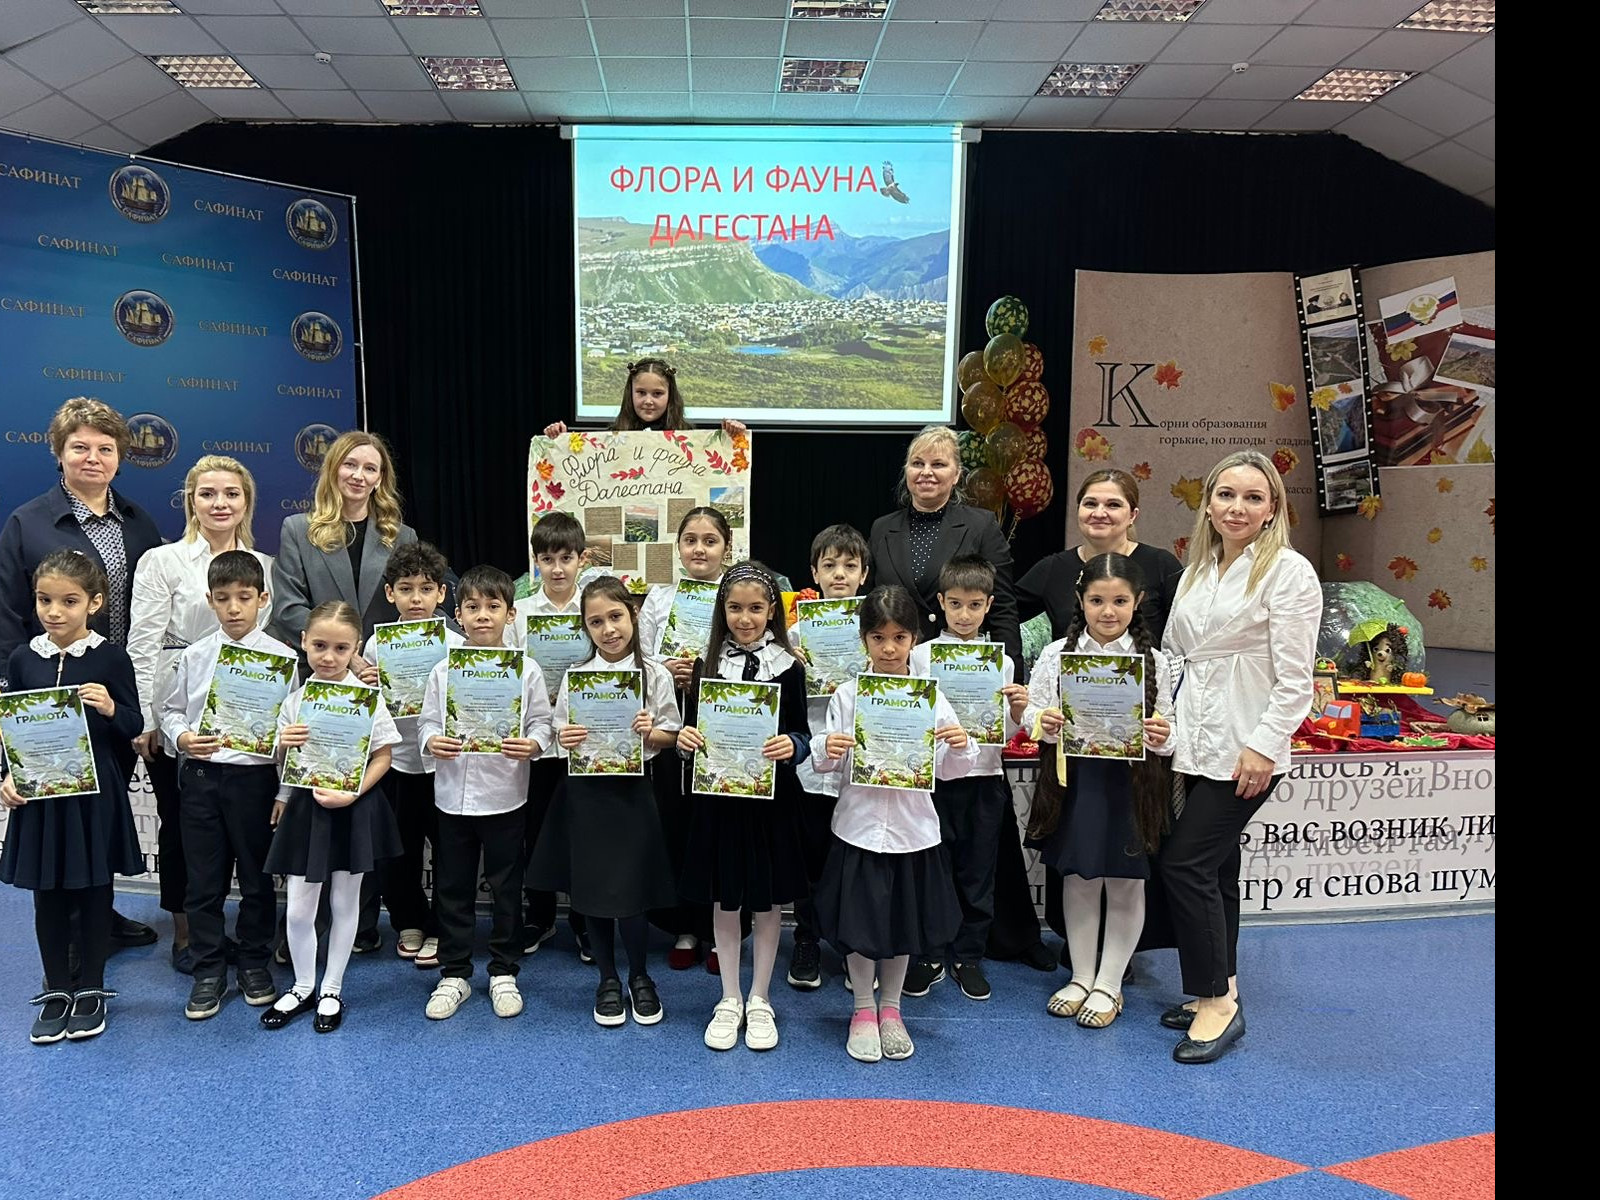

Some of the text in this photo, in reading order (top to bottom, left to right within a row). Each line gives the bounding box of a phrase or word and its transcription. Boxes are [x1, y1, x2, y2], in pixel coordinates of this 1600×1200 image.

[0, 163, 82, 189] САФИНАТ
[609, 164, 878, 194] ФЛОРА И ФАУНА
[194, 199, 264, 221] САФИНАТ
[649, 213, 836, 248] ДАГЕСТАНА
[37, 233, 119, 257] САФИНАТ
[162, 253, 235, 273] САФИНАТ
[272, 267, 338, 287] САФИНАТ
[0, 297, 86, 318] САФИНАТ
[199, 320, 268, 337] САФИНАТ
[42, 366, 126, 384] САФИНАТ
[166, 375, 240, 392] САФИНАТ
[277, 383, 343, 400] САФИНАТ
[1192, 418, 1267, 431] образования
[202, 440, 273, 454] САФИНАТ
[1159, 436, 1208, 448] горькие,
[1211, 437, 1226, 446] но
[1229, 436, 1266, 448] плоды
[562, 446, 708, 489] Флора и фауна
[577, 479, 684, 507] Дагестана
[1286, 486, 1312, 495] кассо
[686, 594, 716, 604] ГРАМО
[810, 617, 855, 629] ГРАМОТА
[390, 638, 434, 651] ГРАМОТА
[539, 632, 582, 642] ГРАМОТА
[229, 666, 278, 683] ГРАМОТА
[462, 670, 510, 680] ГРАМОТА
[943, 663, 991, 673] ГРАМОТА
[1075, 675, 1128, 686] ГРАМОТА
[581, 692, 628, 701] ГРАМОТА
[871, 696, 922, 710] ГРАМОТА
[16, 711, 70, 725] ГРАМОТА
[313, 702, 361, 717] ГРАМОТА
[713, 704, 763, 717] ГРАМОТА
[1288, 762, 1373, 780] аюсь
[1427, 760, 1495, 791] Вно
[1262, 821, 1320, 845] вас
[1330, 816, 1448, 842] возник
[1238, 878, 1283, 911] гр
[1293, 877, 1313, 899] я
[1324, 871, 1421, 898] снова
